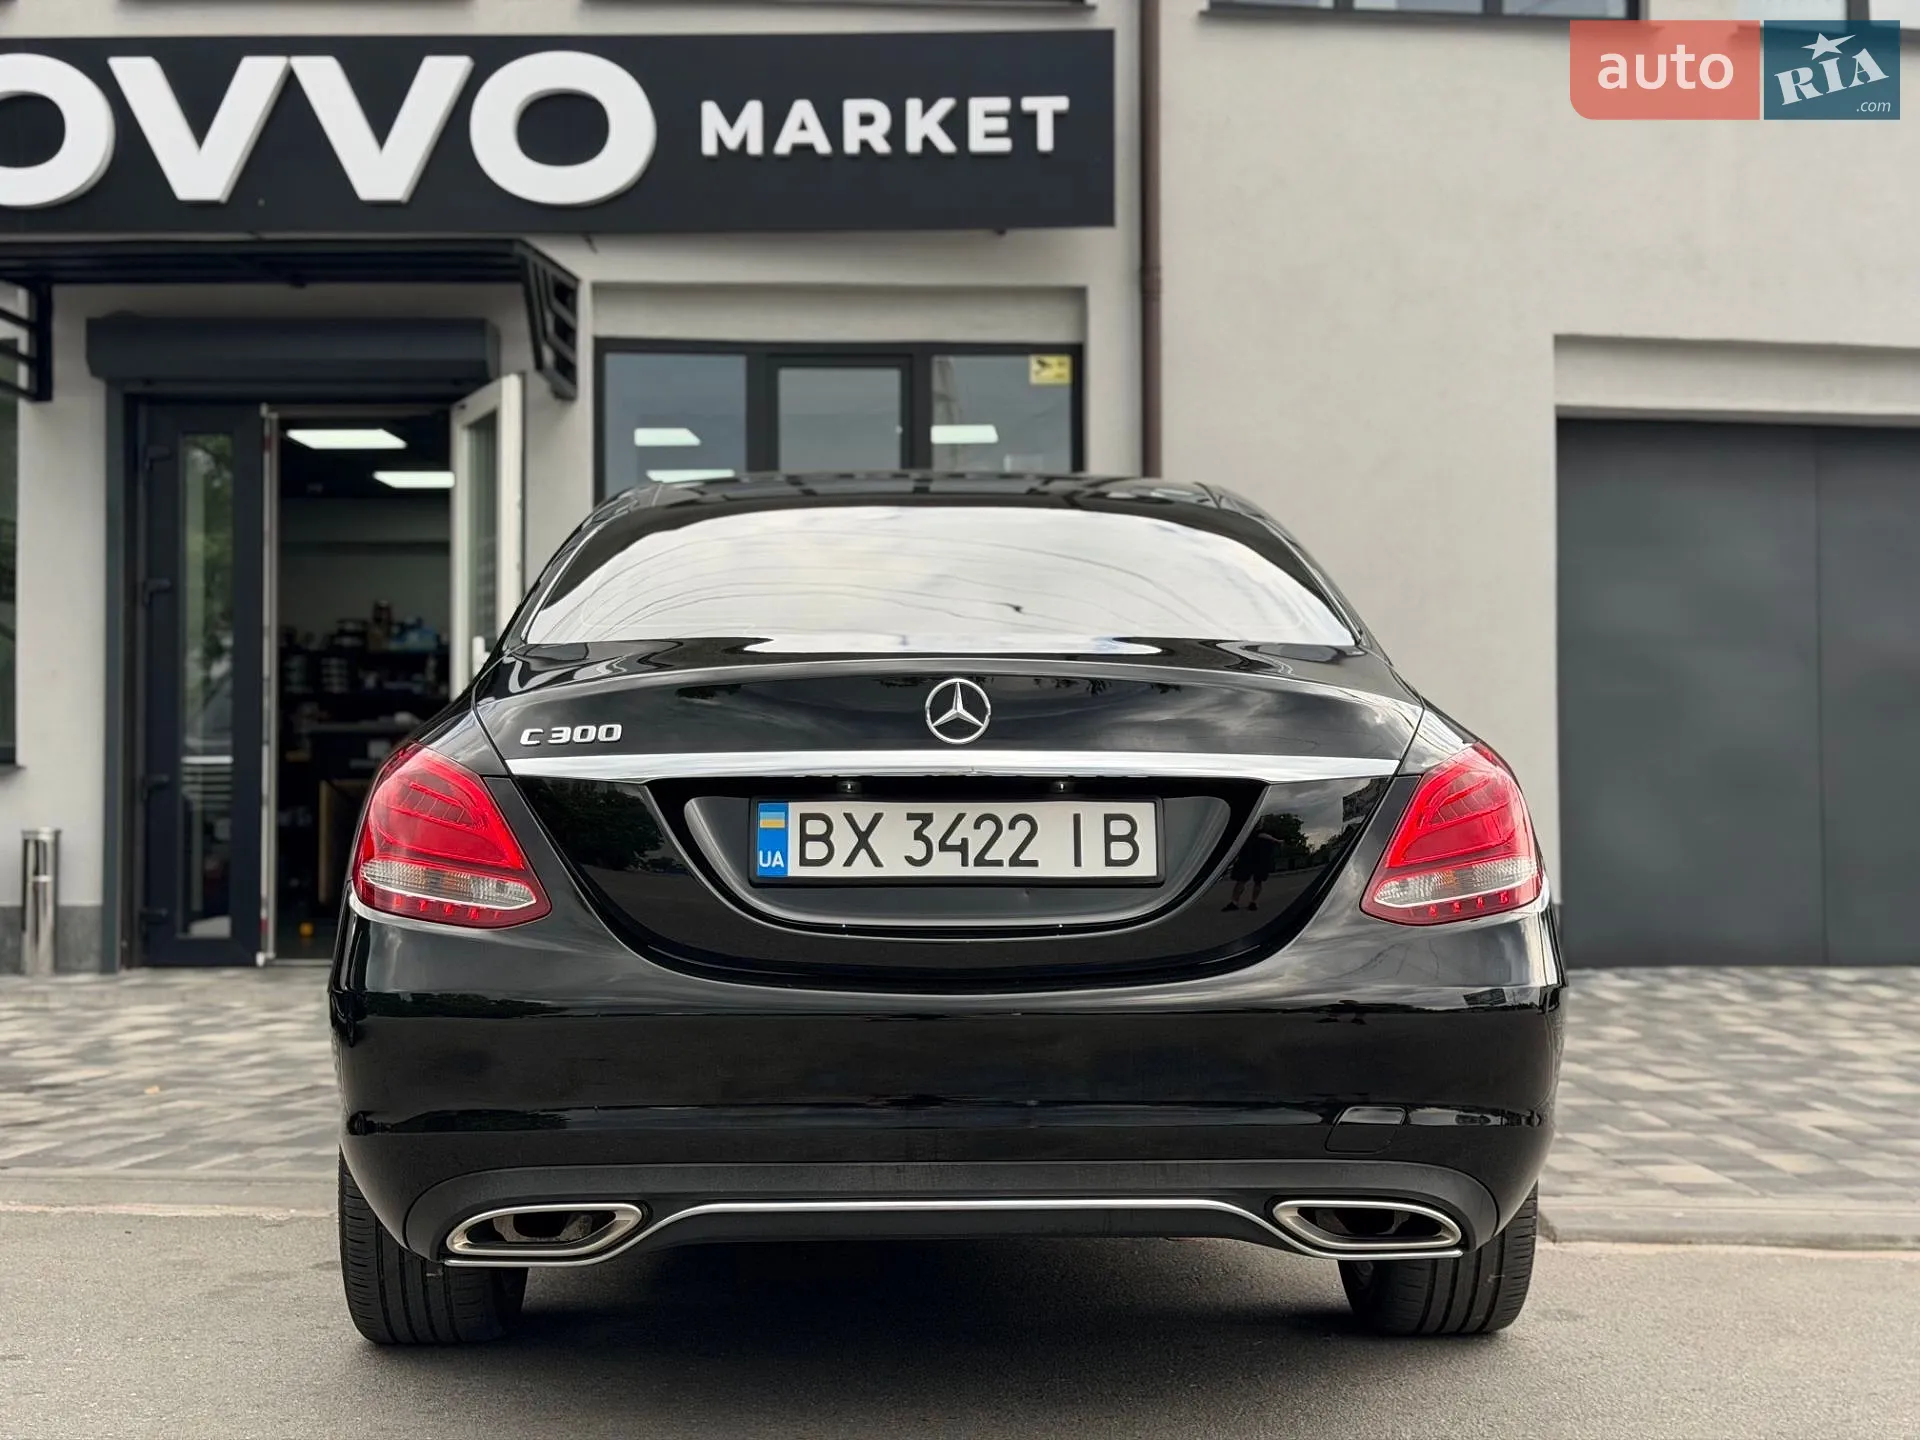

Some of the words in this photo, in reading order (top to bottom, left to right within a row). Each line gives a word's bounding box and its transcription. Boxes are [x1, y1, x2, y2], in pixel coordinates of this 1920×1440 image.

[0, 50, 657, 208] OVVO
[700, 95, 1071, 157] MARKET
[520, 727, 544, 746] C
[547, 723, 623, 745] 300
[759, 850, 785, 868] UA
[799, 812, 884, 868] BX
[903, 812, 1039, 868] 3422
